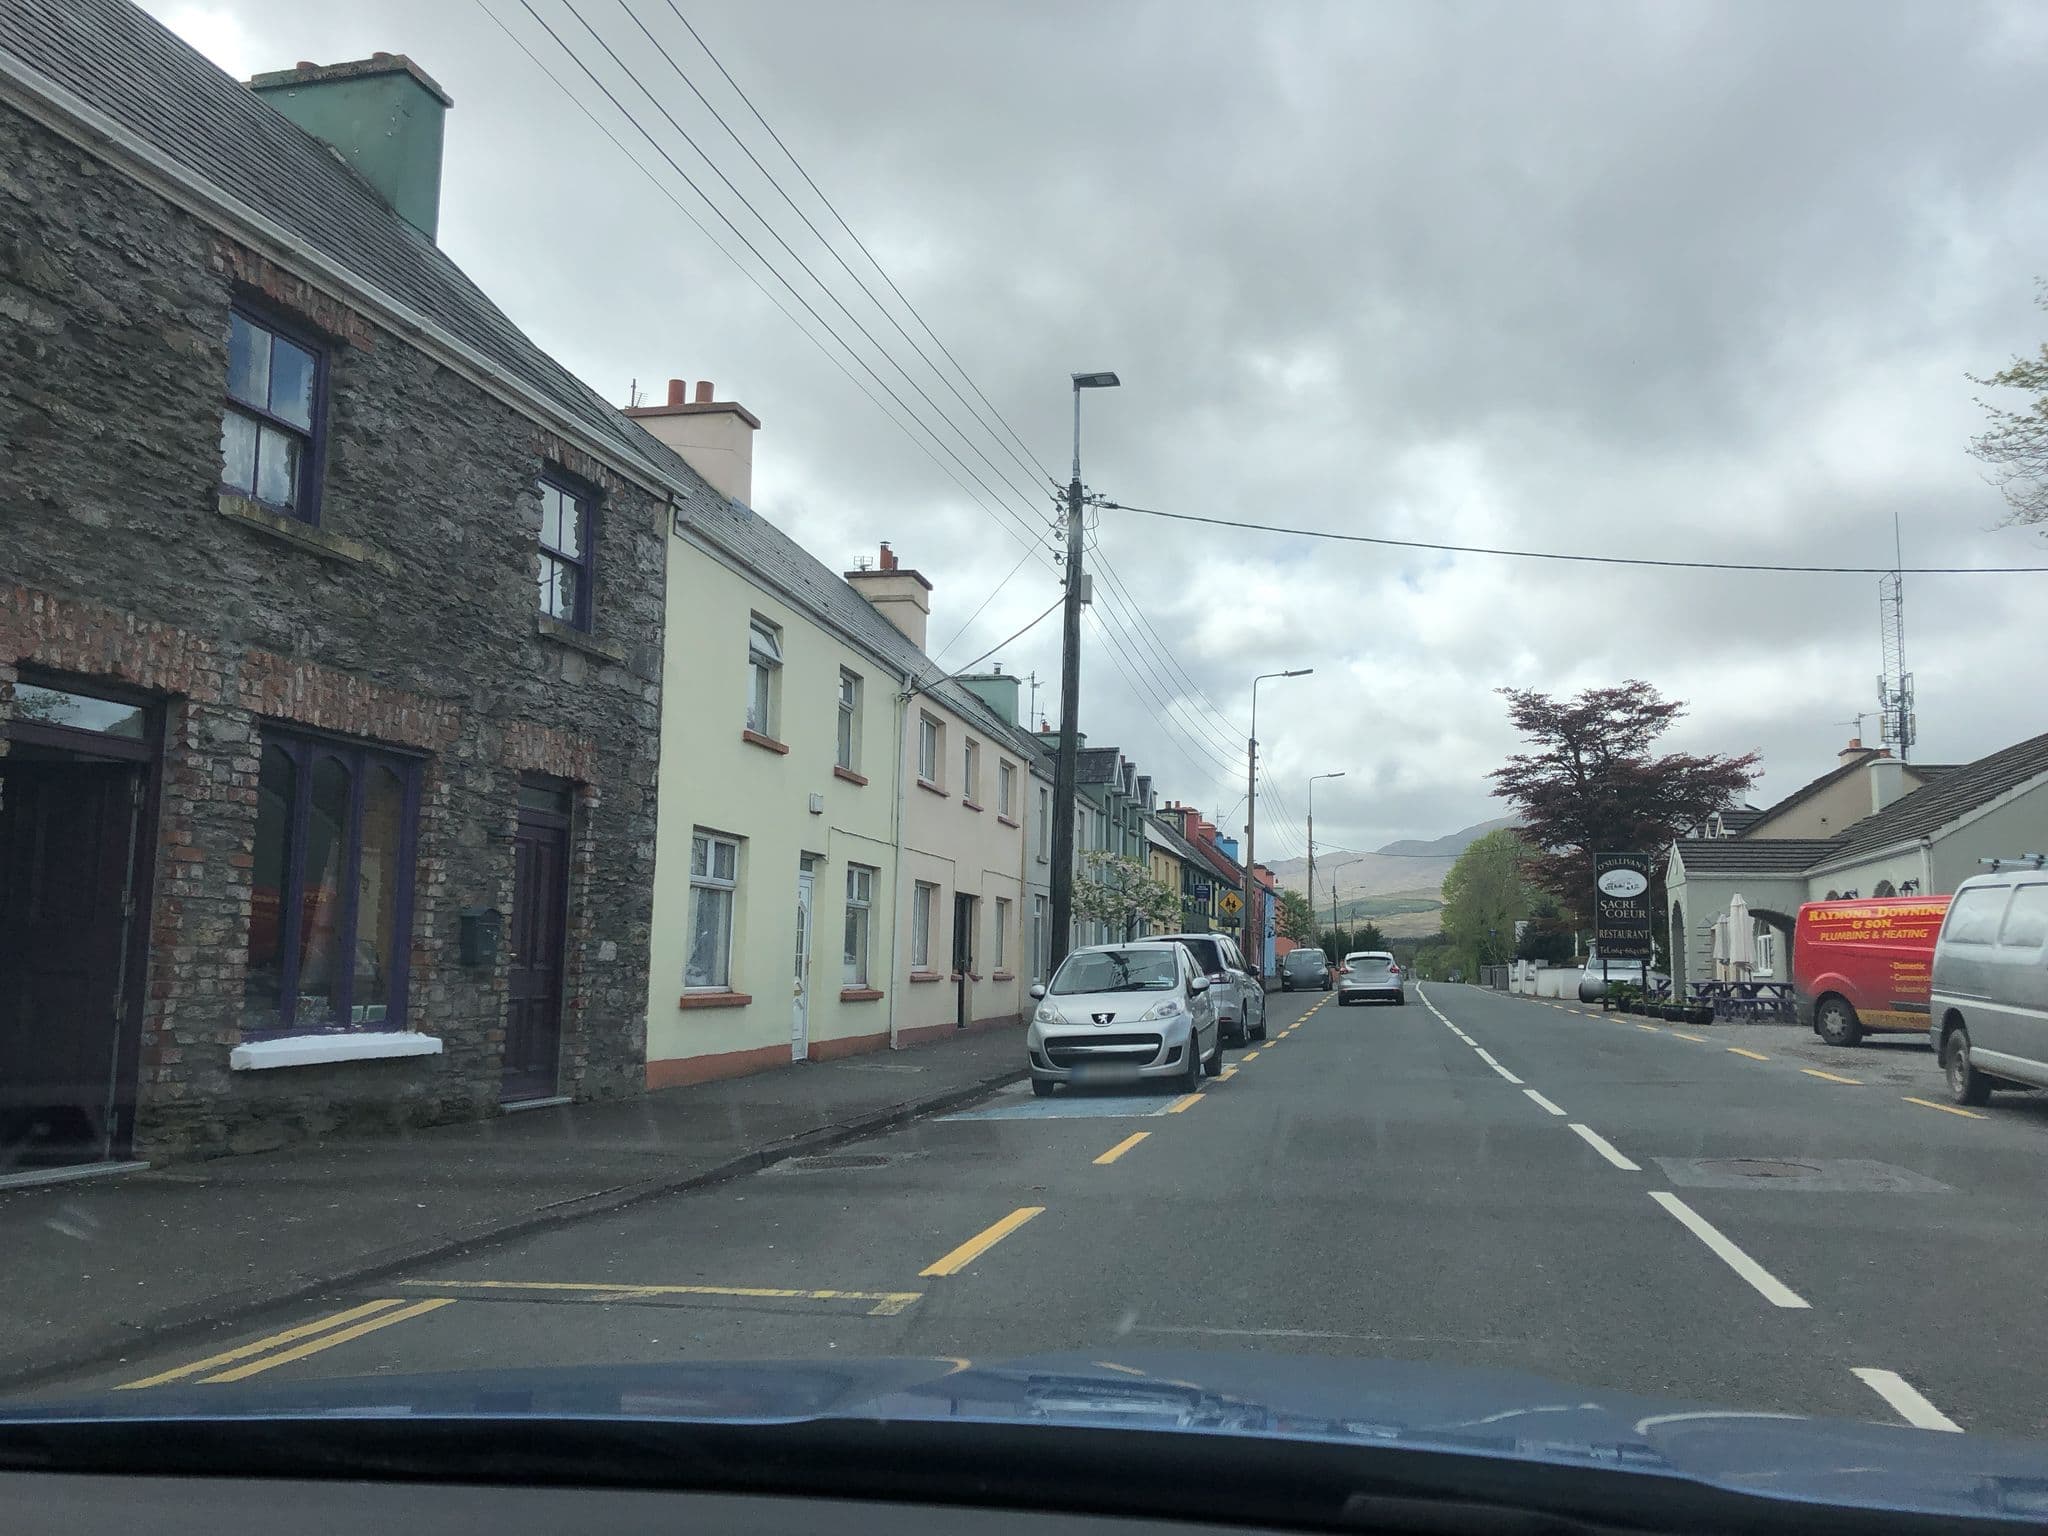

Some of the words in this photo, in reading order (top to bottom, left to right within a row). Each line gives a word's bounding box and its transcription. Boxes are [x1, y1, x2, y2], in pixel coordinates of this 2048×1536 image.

[1600, 900, 1637, 911] SACRE
[1605, 909, 1646, 919] COEUR
[1808, 910, 1871, 921] RAYMOND
[1877, 906, 1947, 918] DOWNING
[1852, 920, 1863, 929] &
[1599, 929, 1649, 939] RESTAURANT
[1820, 930, 1870, 941] PLUMBING
[1872, 931, 1880, 939] &
[1882, 928, 1929, 939] HEATING
